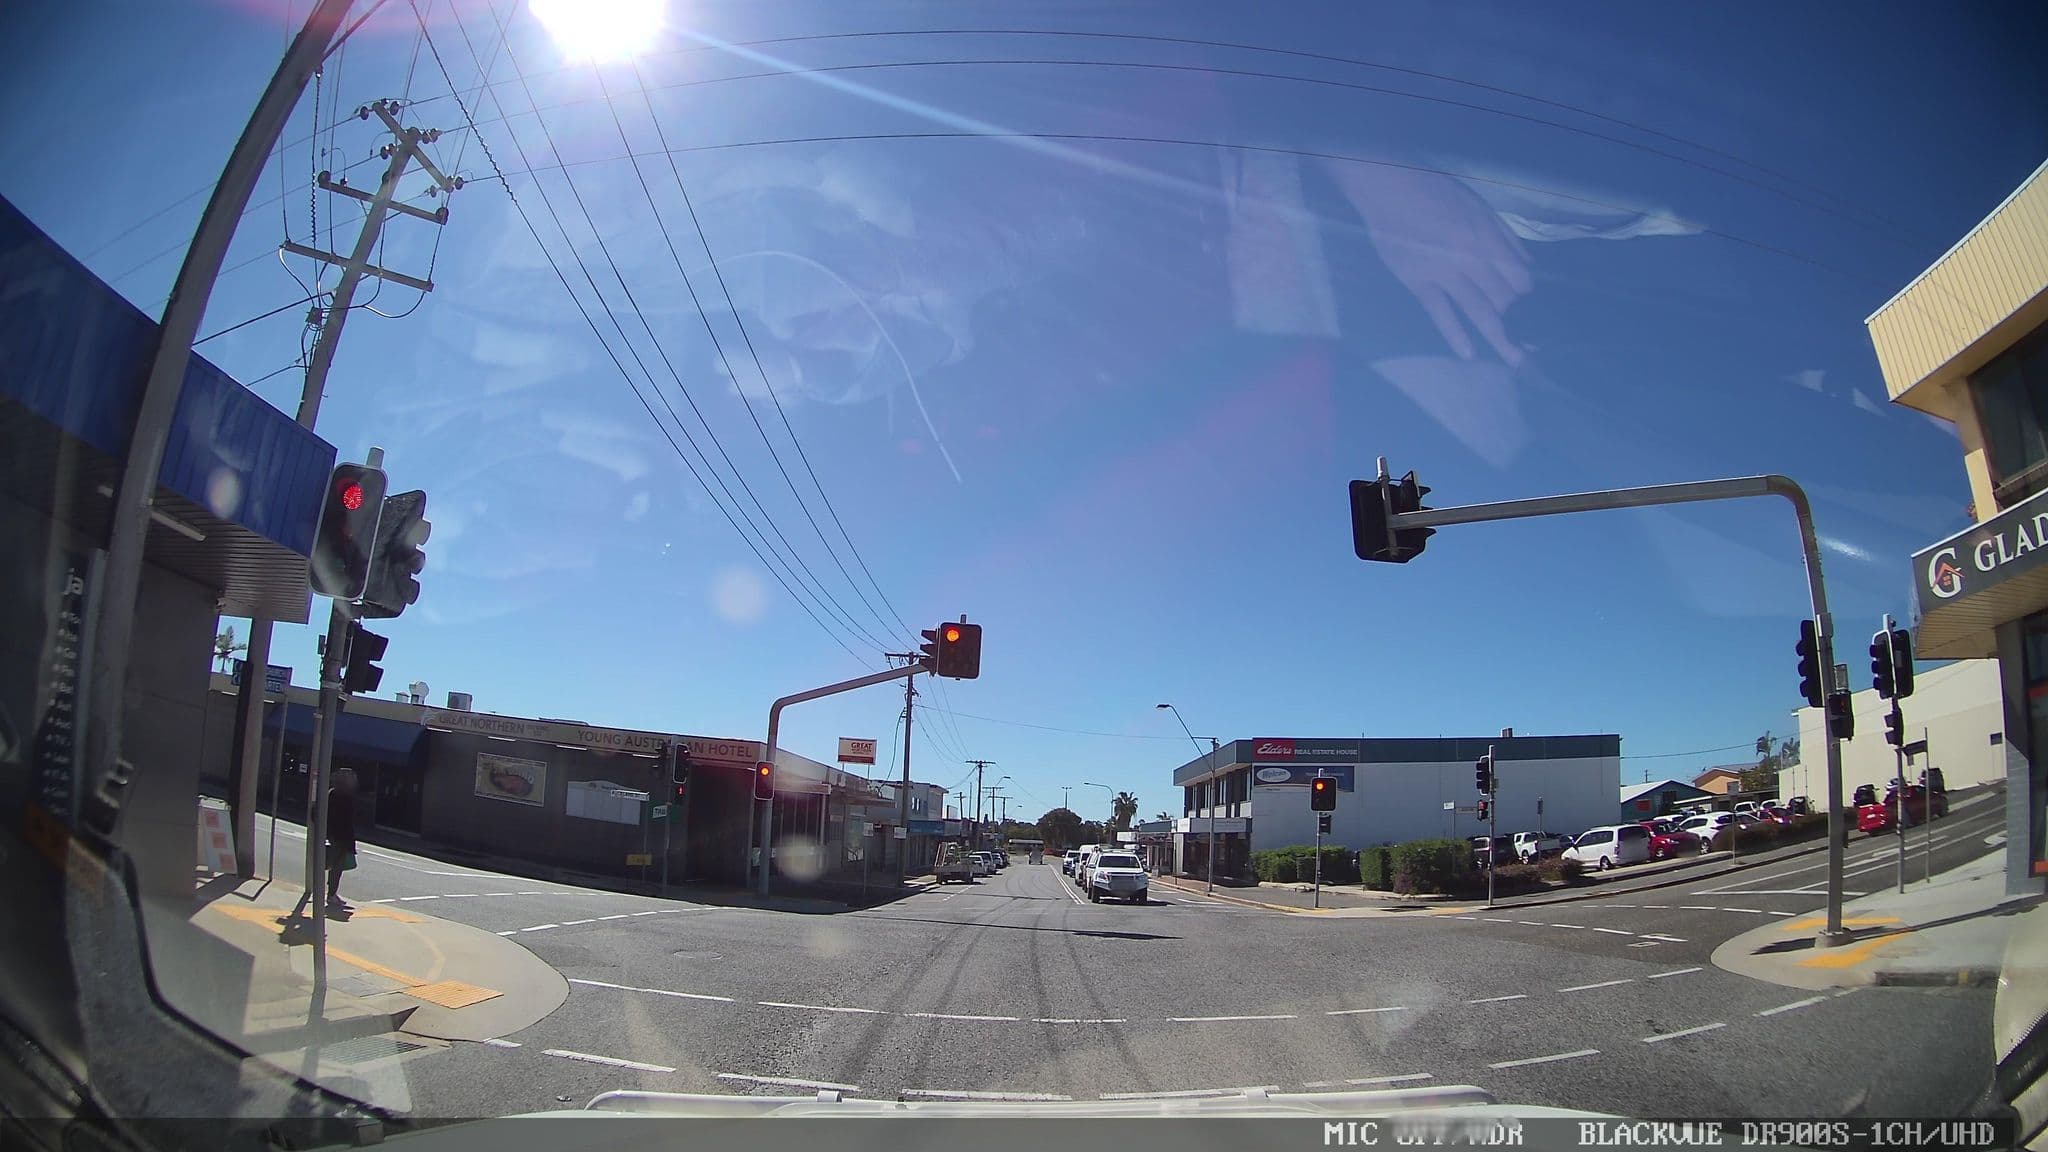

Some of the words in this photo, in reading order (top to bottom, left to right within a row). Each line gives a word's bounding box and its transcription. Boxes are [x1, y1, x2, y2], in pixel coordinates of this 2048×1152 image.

[472, 718, 525, 735] NORTHERN
[577, 729, 622, 745] YOUNG
[708, 744, 752, 758] HOTEL
[851, 742, 873, 750] GREAT
[1257, 743, 1292, 755] Elders
